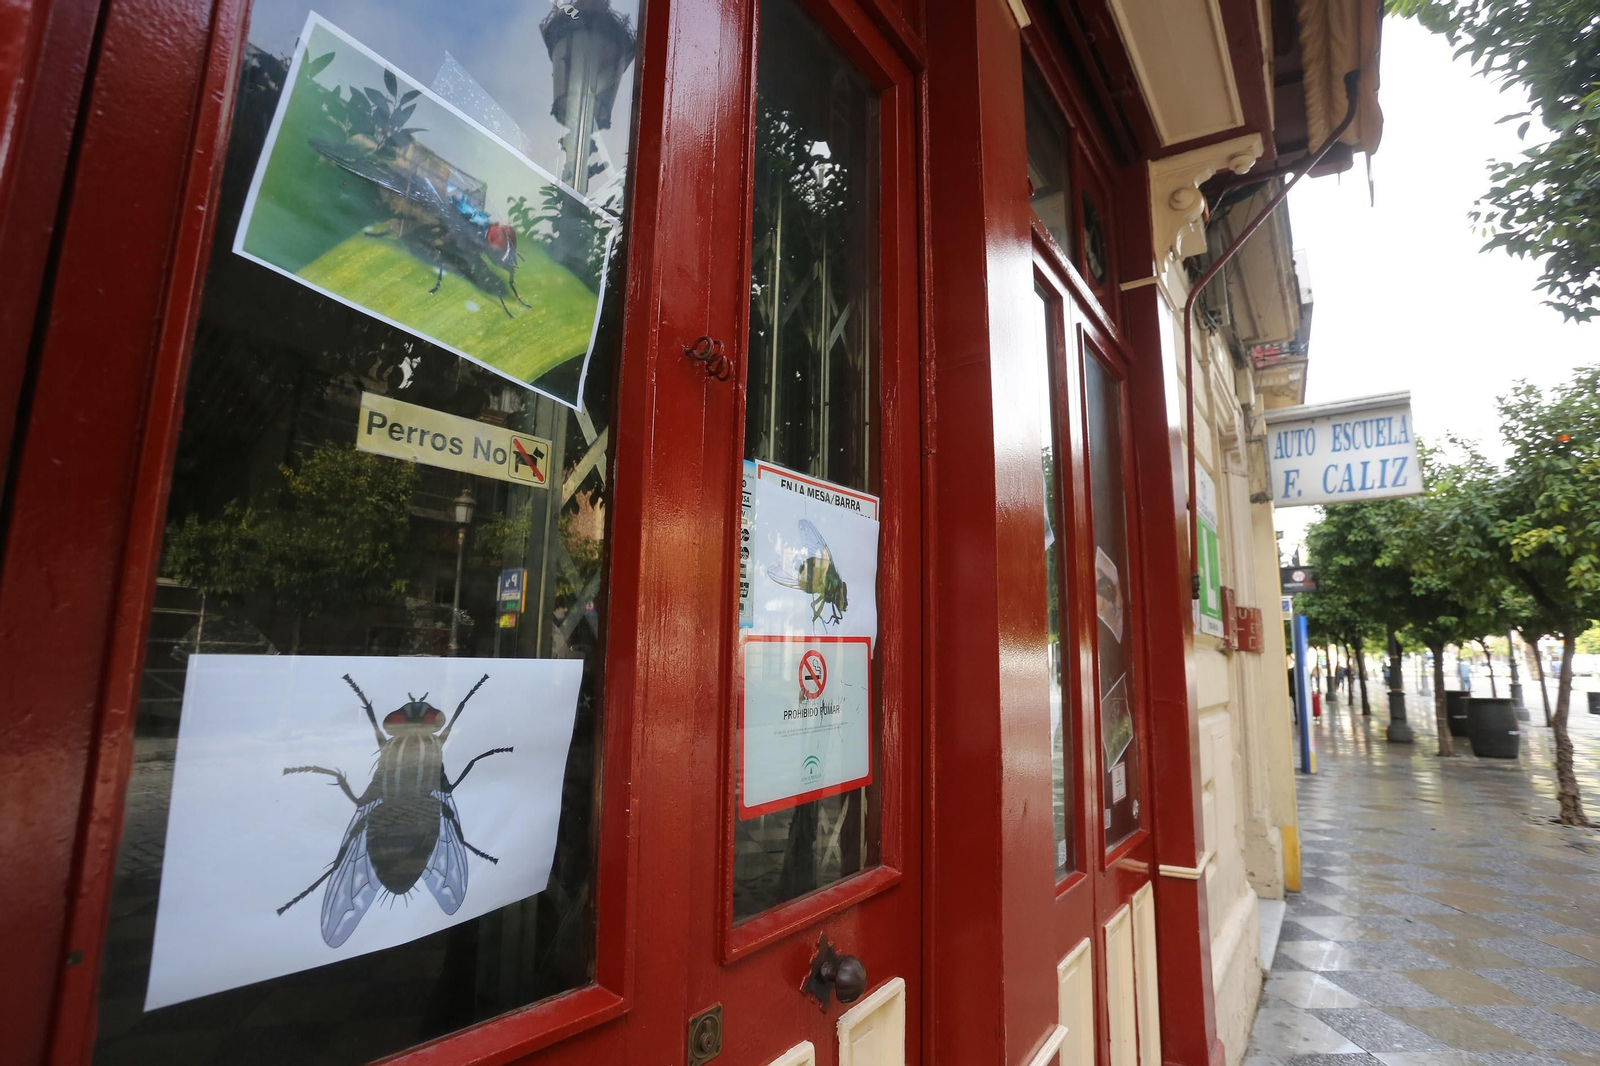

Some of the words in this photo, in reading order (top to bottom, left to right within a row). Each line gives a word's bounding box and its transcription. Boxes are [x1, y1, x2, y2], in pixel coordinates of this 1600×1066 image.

[366, 410, 463, 455] Perros
[473, 436, 507, 465] No
[1274, 427, 1316, 459] AUTO
[1331, 415, 1410, 452] ESCUELA
[1282, 469, 1303, 499] F.
[1322, 456, 1409, 495] CALIZ
[783, 707, 819, 720] PROHIBIDO
